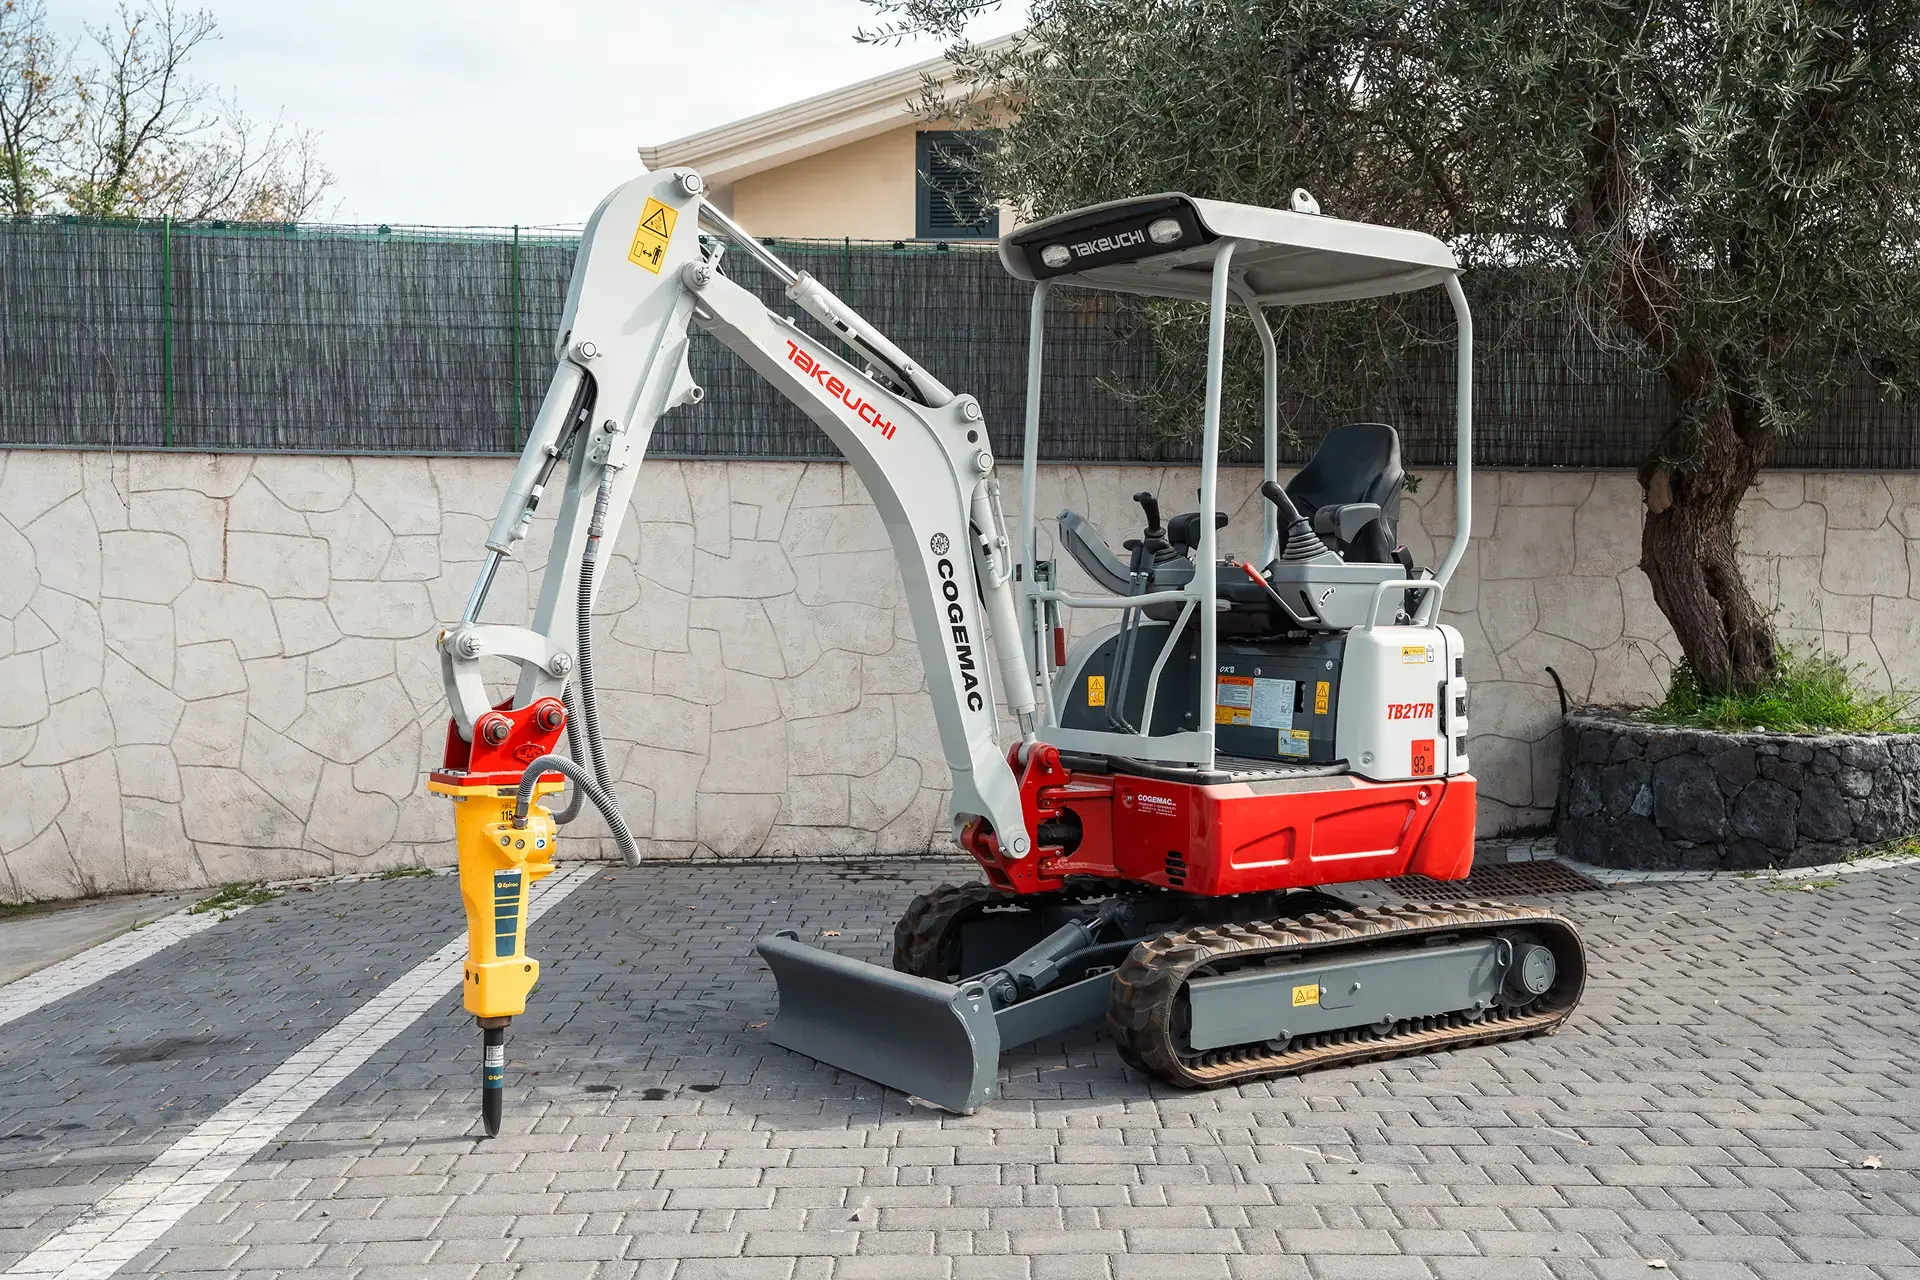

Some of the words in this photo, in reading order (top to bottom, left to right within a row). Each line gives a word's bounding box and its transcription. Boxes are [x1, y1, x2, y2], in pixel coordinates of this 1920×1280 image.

[937, 558, 983, 713] COGEMAC
[1387, 703, 1434, 720] TB217R
[1413, 755, 1425, 773] 93
[1137, 794, 1173, 805] COGEMAC
[501, 810, 513, 821] 115
